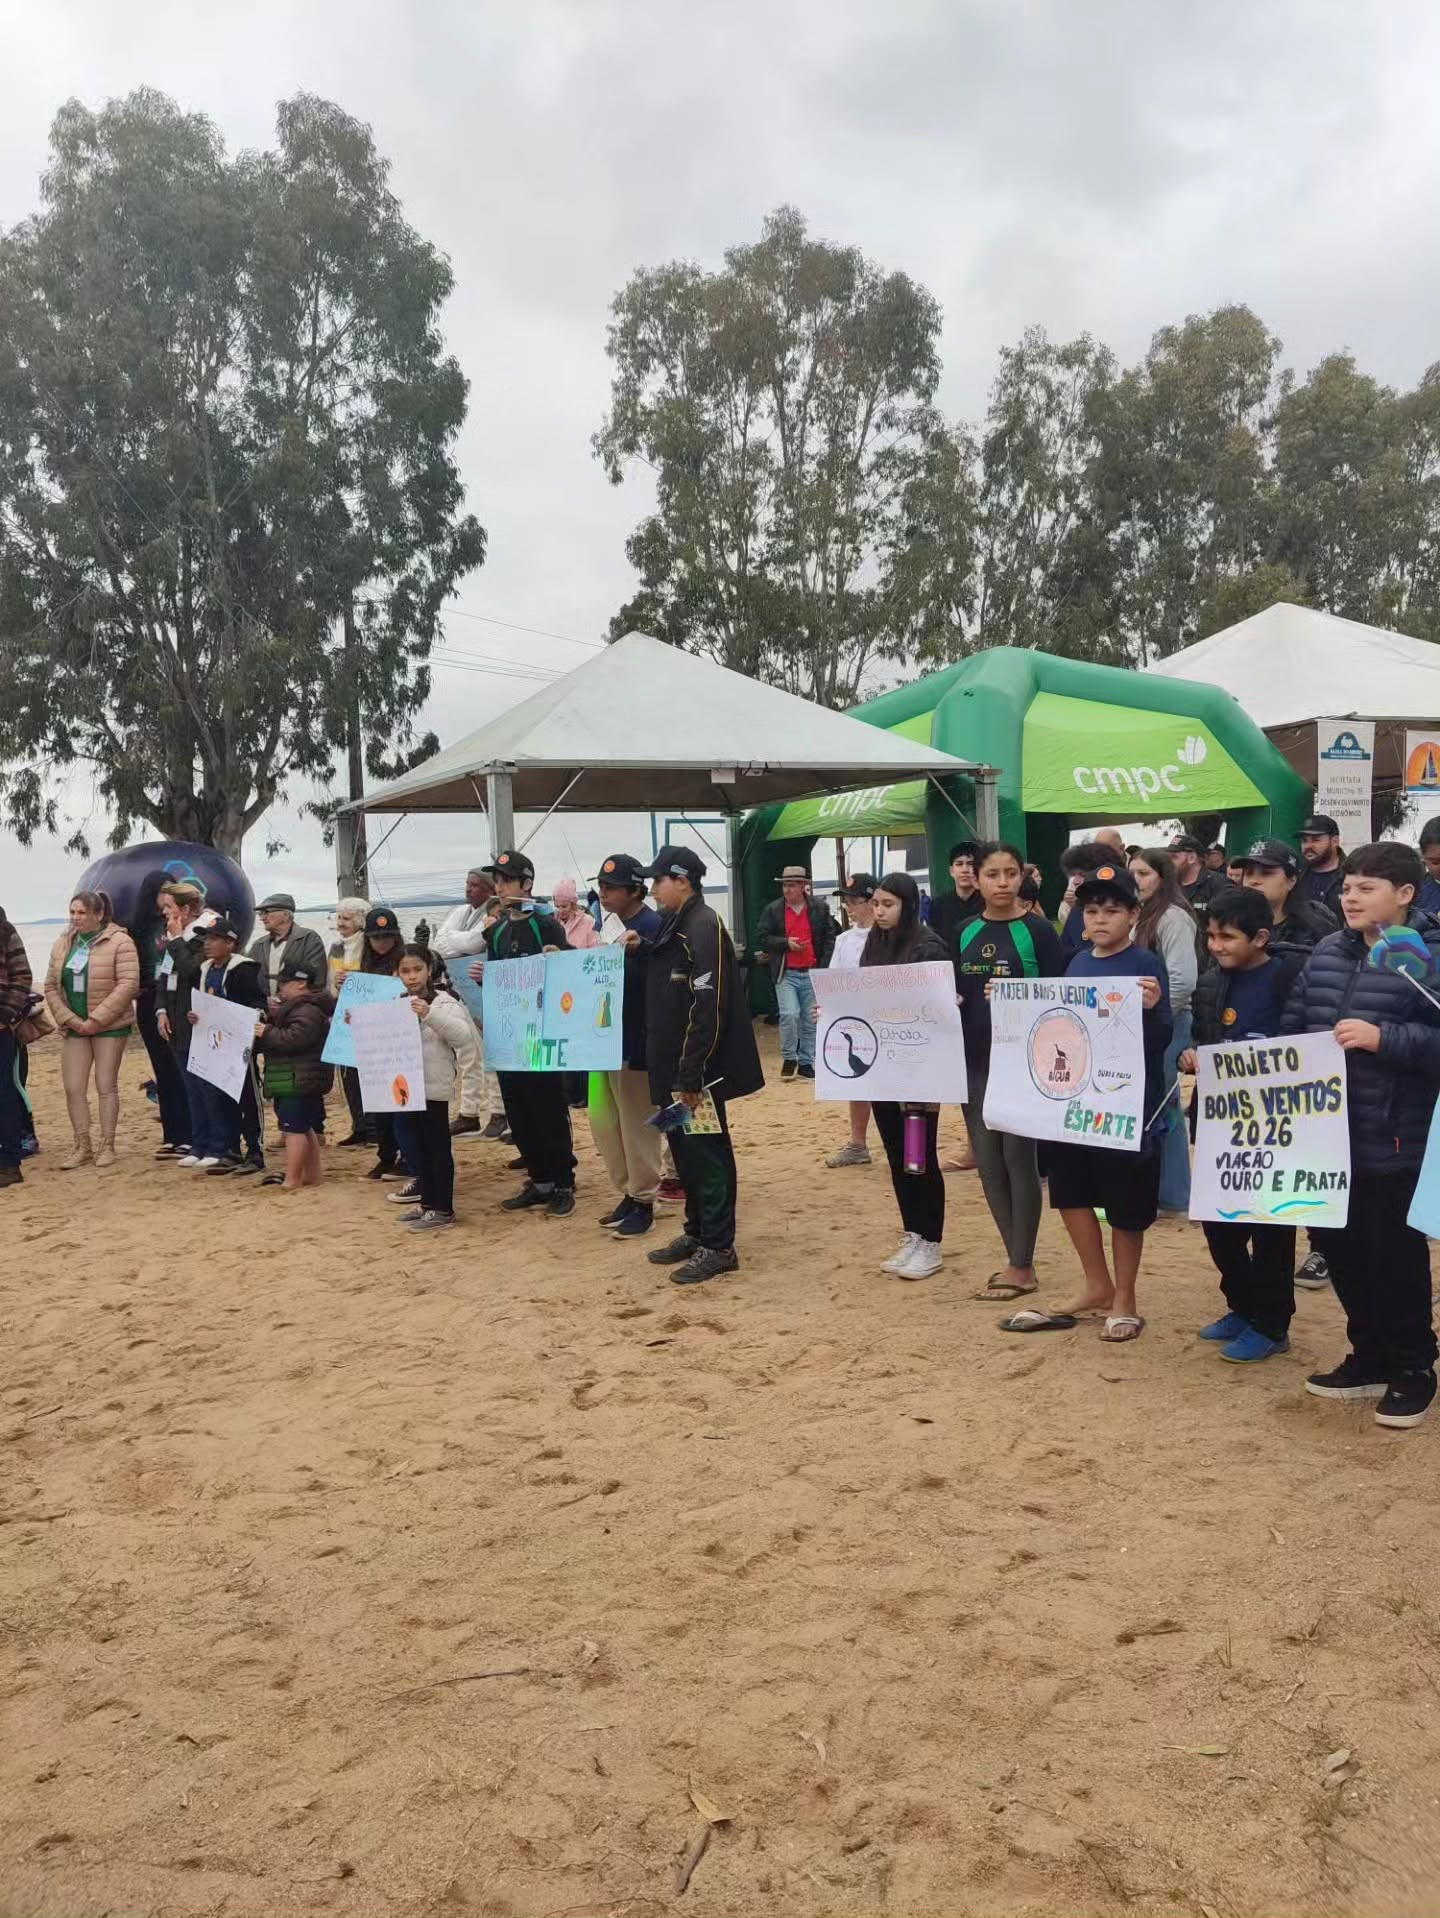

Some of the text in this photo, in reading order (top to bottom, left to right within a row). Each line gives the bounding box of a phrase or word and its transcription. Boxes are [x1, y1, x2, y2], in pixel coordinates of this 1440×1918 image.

[1073, 764, 1186, 802] cmpc
[818, 784, 897, 820] cmpc
[1212, 1046, 1299, 1079] PROJETO
[1205, 1076, 1342, 1120] BONS VENTOS
[1231, 1116, 1293, 1147] 2026
[1216, 1147, 1274, 1172] VIAÇÃO
[1220, 1169, 1348, 1192] OURO E PRATA
